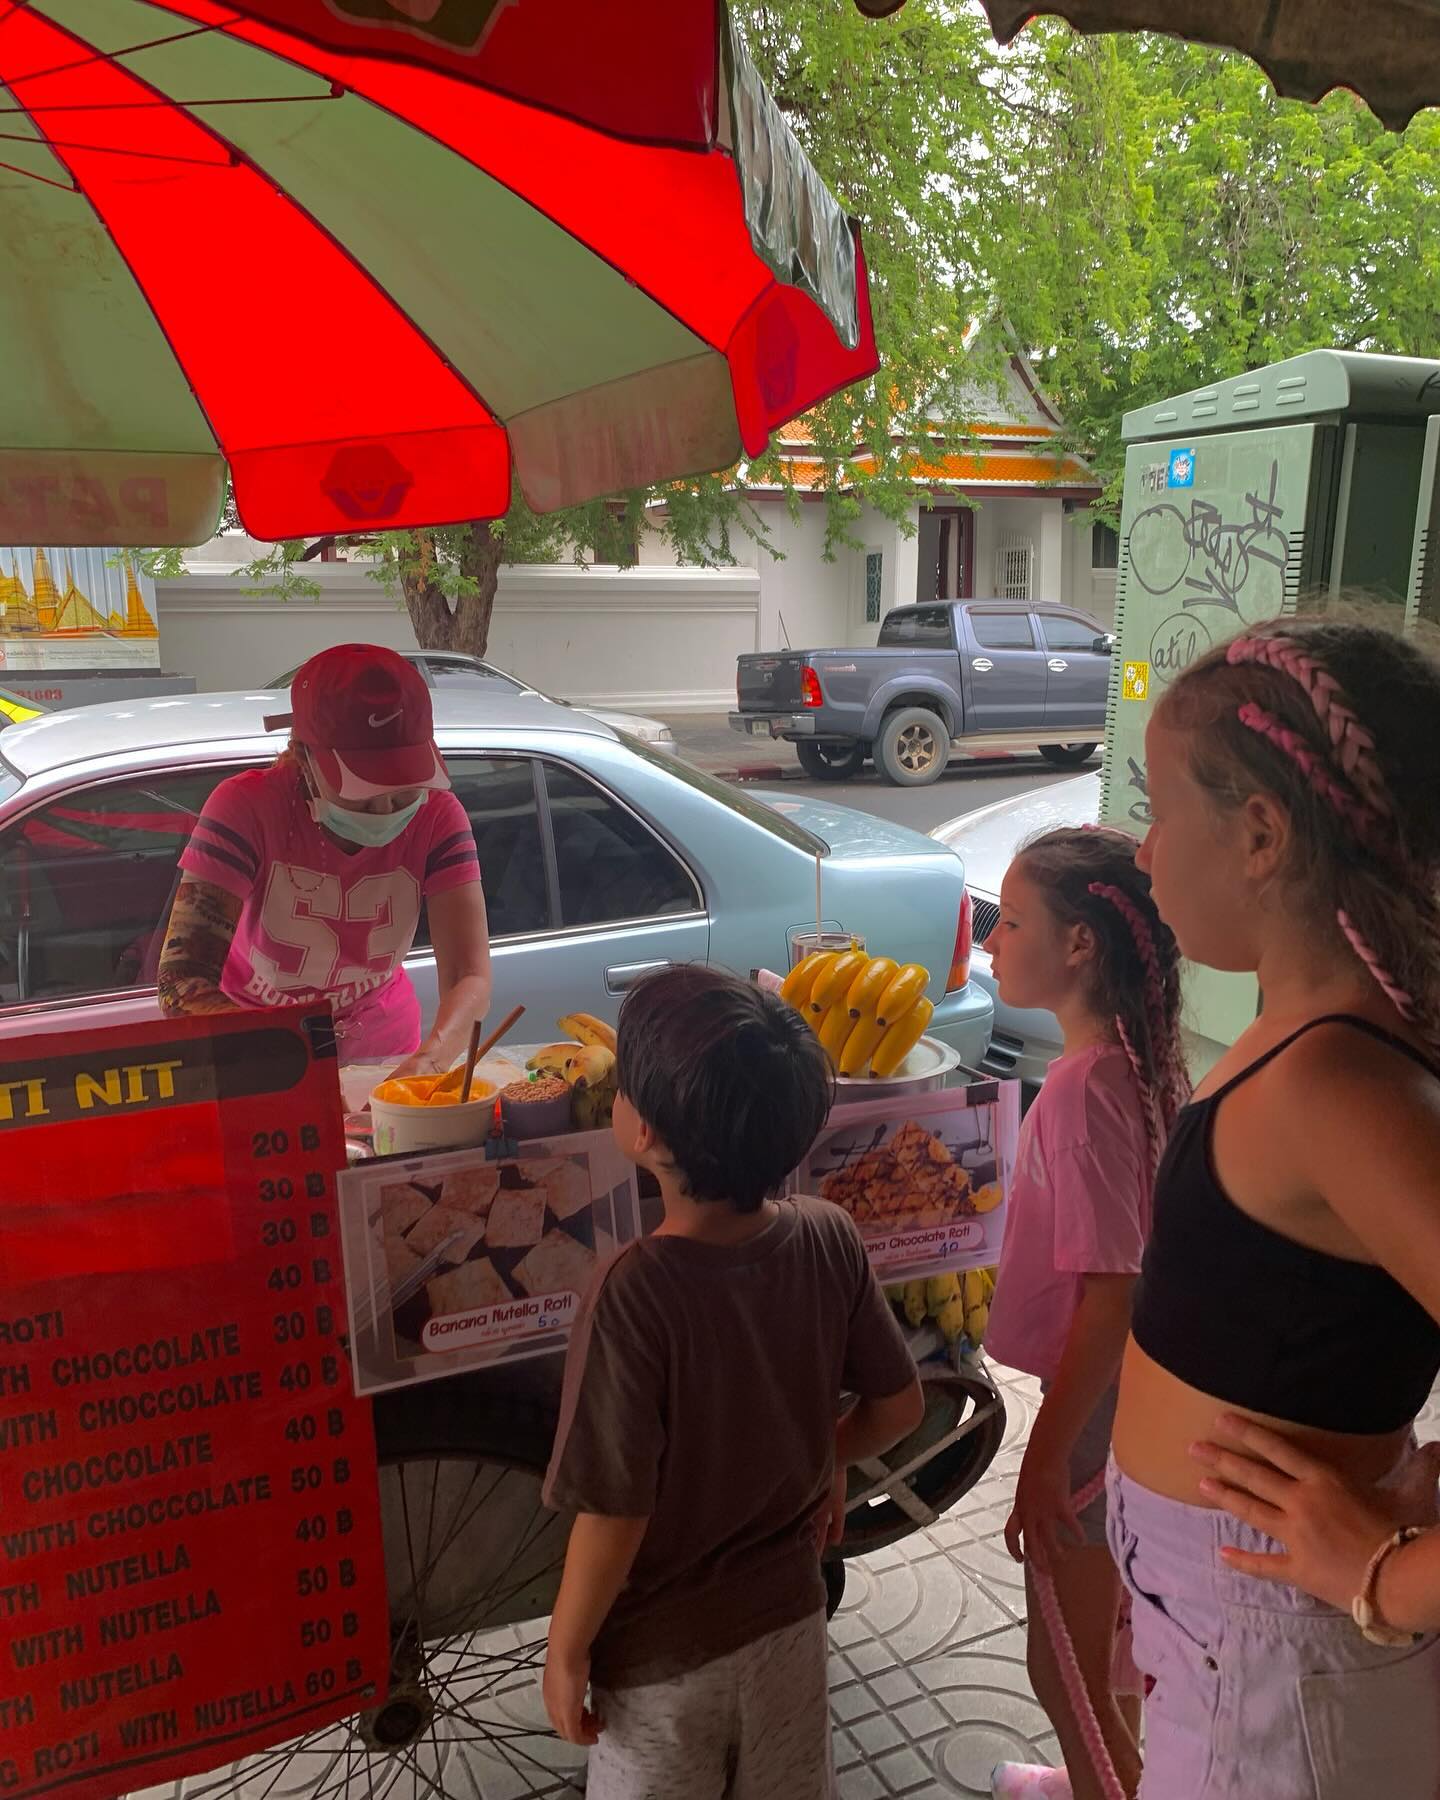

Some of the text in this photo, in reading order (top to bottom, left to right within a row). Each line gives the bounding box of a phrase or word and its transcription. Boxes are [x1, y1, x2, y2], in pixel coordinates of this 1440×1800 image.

[75, 1060, 183, 1109] NIT
[252, 1125, 320, 1158] 20 B
[259, 1173, 325, 1202] 30 B
[262, 1212, 329, 1246] 30 B
[890, 1231, 945, 1249] Chocolate
[949, 1226, 970, 1239] Roti
[268, 1265, 301, 1291] 40
[314, 1259, 331, 1283] B
[52, 1324, 241, 1387] CHOCCOLATE
[274, 1312, 305, 1343] 30
[317, 1306, 333, 1335] B
[429, 1314, 487, 1337] Banana
[492, 1299, 539, 1323] Nutella
[544, 1294, 572, 1314] Roti
[78, 1371, 262, 1431] CHOCCOLATE
[280, 1364, 311, 1391] 40
[322, 1358, 338, 1384] B
[23, 1409, 345, 1502] CHOCCOLATE 40 B
[2, 1459, 350, 1559] WITH CHOCCOLATE 50 B
[66, 1544, 191, 1600] NUTELLA
[296, 1514, 326, 1542] 40
[338, 1508, 353, 1534] B
[11, 1559, 356, 1668] WITH NUTELLA 50 B
[60, 1654, 183, 1712] NUTELLA
[301, 1619, 331, 1647] 50
[343, 1612, 359, 1638] B
[35, 1731, 99, 1778] ROTI
[120, 1709, 178, 1748] WITH
[195, 1681, 296, 1731] NUTELLA
[306, 1668, 336, 1696] 60
[347, 1659, 362, 1681] B
